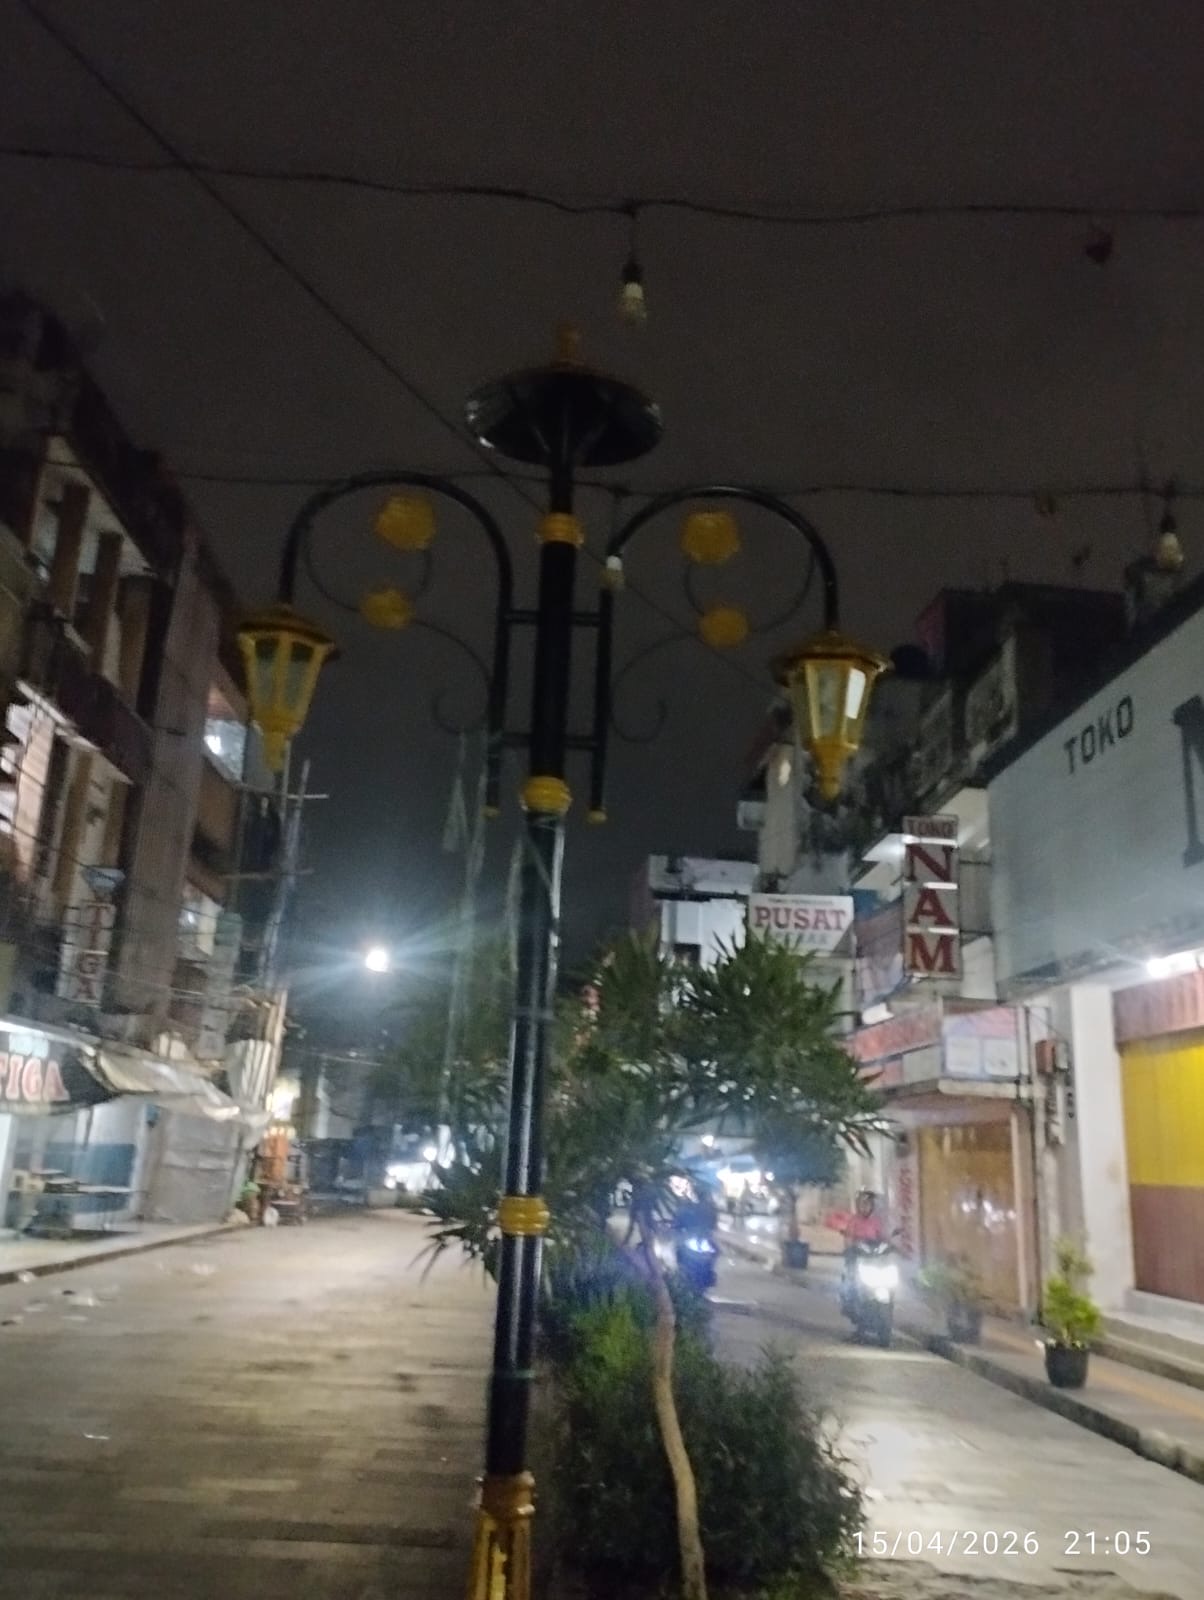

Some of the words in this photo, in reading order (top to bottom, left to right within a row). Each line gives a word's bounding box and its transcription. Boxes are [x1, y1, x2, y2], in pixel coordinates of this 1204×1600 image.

[1064, 696, 1133, 774] TOKO
[755, 906, 846, 930] PUSAT
[905, 845, 955, 972] NAM
